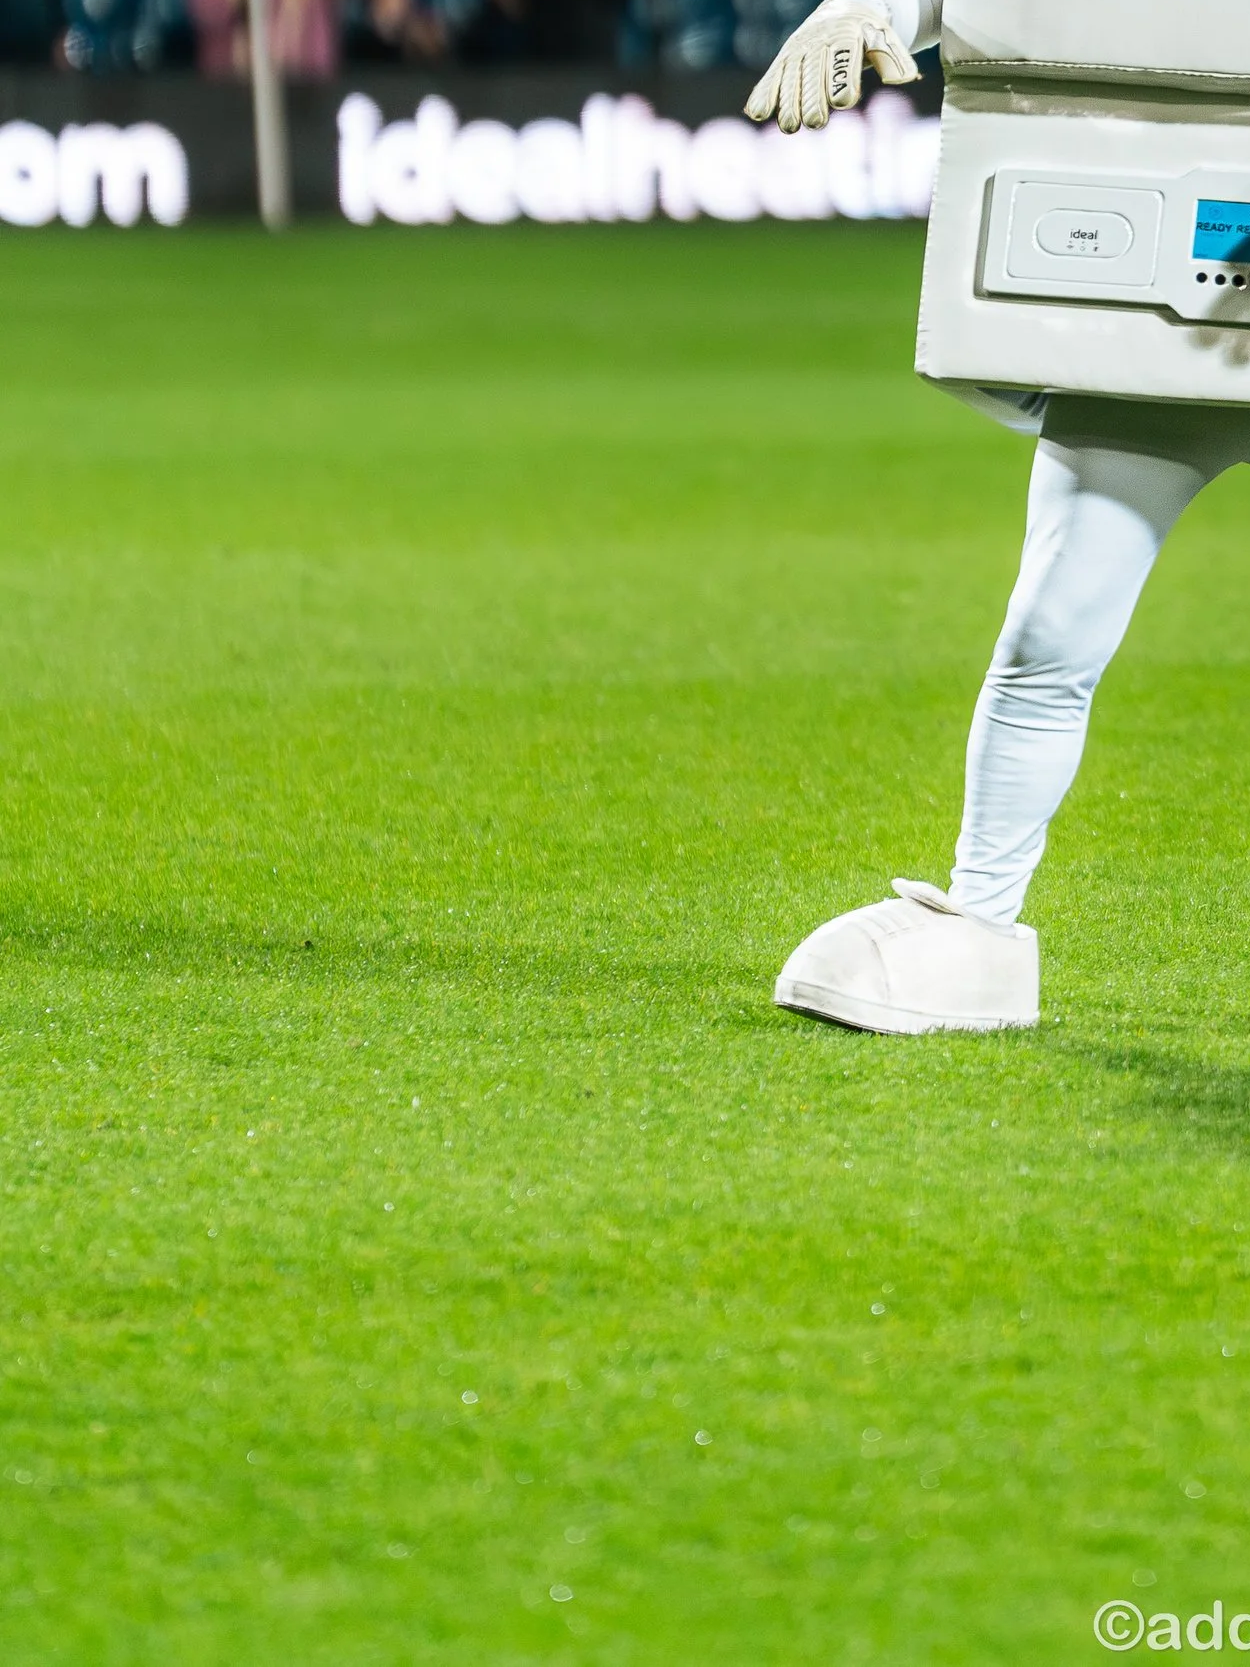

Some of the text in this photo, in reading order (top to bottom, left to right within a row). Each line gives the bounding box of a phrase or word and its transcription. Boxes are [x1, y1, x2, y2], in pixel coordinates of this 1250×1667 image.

[832, 48, 851, 97] LUCA
[1196, 221, 1233, 233] READY
[1069, 228, 1099, 240] ideal
